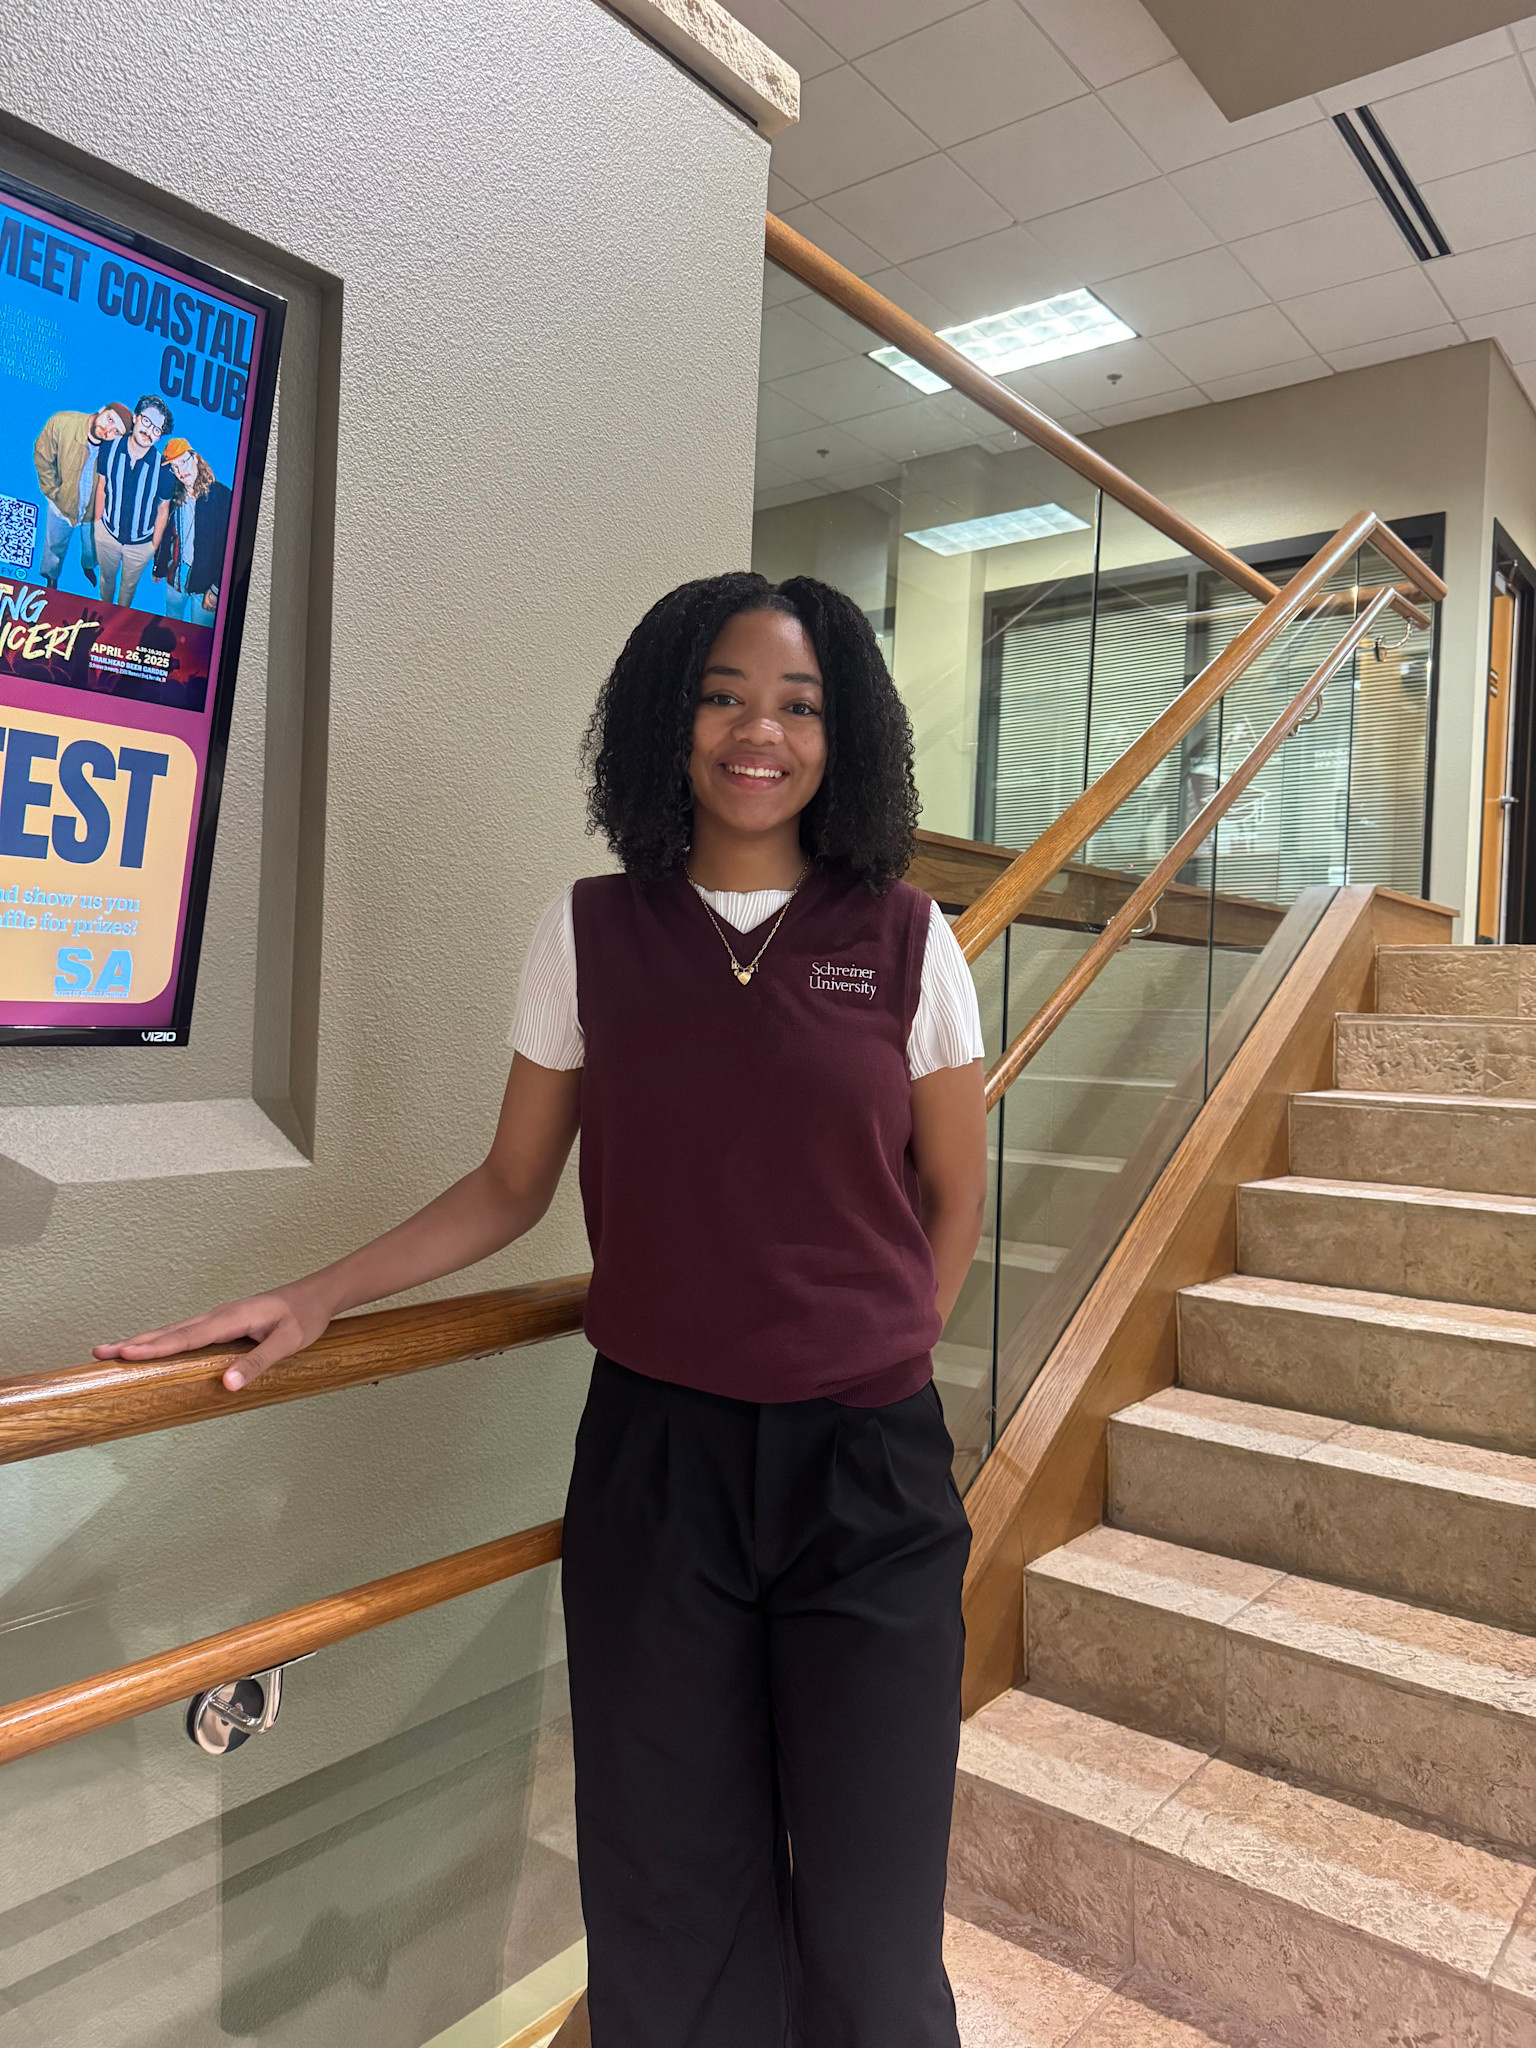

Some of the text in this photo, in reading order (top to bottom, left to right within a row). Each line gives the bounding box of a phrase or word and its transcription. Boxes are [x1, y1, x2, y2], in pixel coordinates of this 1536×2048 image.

[97, 261, 256, 370] COASTAL
[160, 346, 246, 421] CLUB
[91, 642, 170, 668] APRIL 26, 2025
[0, 727, 169, 869] EST
[22, 887, 77, 908] show
[80, 895, 103, 910] us
[105, 897, 140, 915] you
[40, 912, 71, 932] for
[72, 916, 138, 937] prizes!
[54, 946, 134, 992] SA
[811, 961, 876, 979] Schreiner
[809, 976, 877, 1000] University
[141, 1031, 177, 1043] VIZIO
